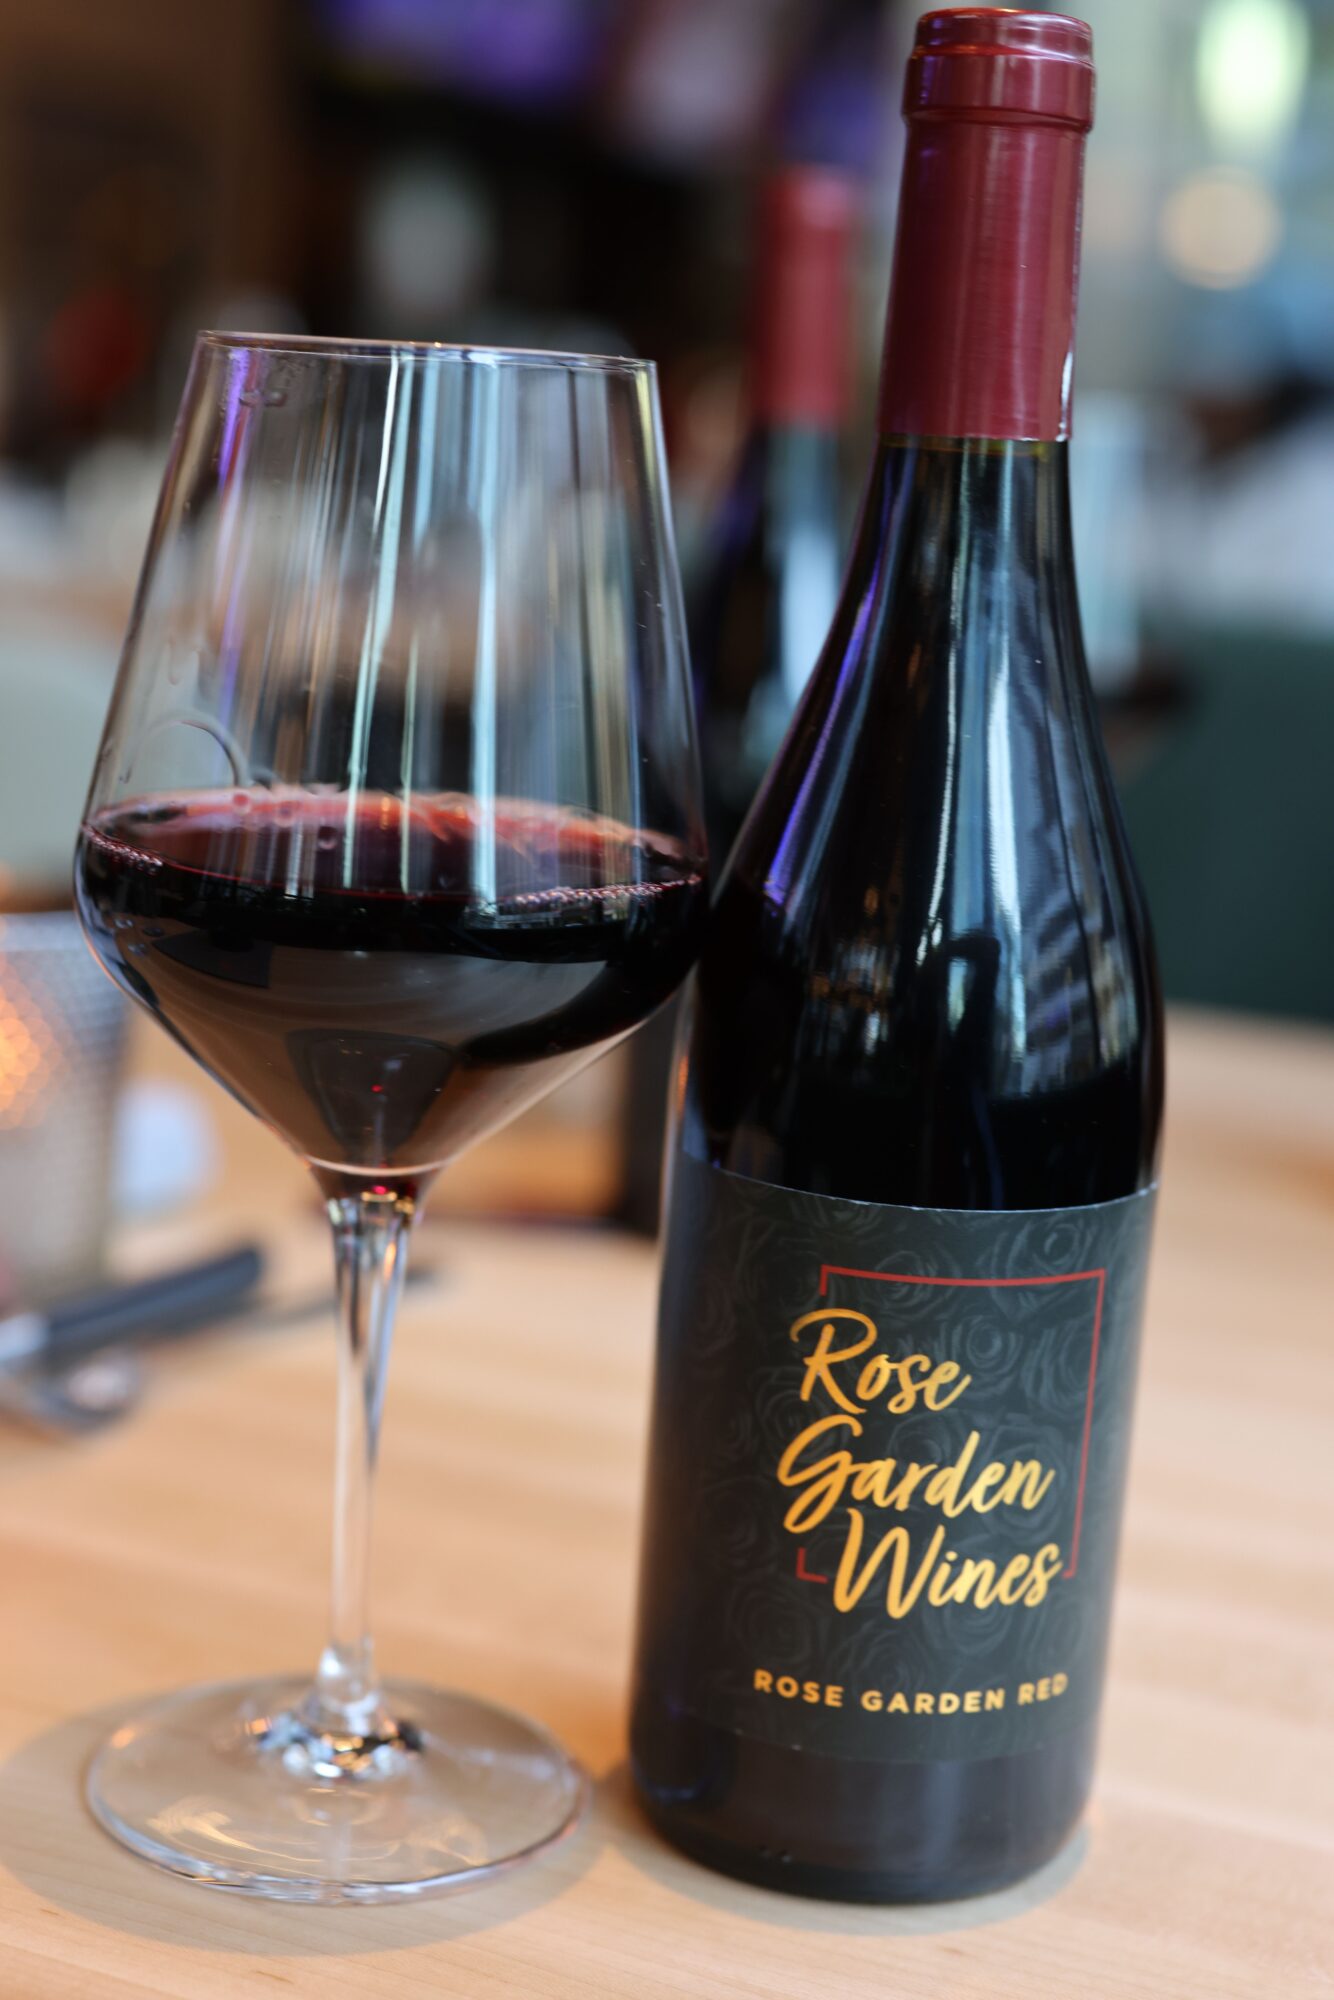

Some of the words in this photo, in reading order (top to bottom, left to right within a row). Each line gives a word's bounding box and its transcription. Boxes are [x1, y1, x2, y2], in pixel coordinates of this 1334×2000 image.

[790, 1307, 972, 1415] Rose
[776, 1413, 1055, 1534] Garden
[832, 1507, 1063, 1620] Wines
[753, 1668, 844, 1708] ROSE
[860, 1687, 1006, 1714] GARDEN
[1016, 1671, 1069, 1706] RED
